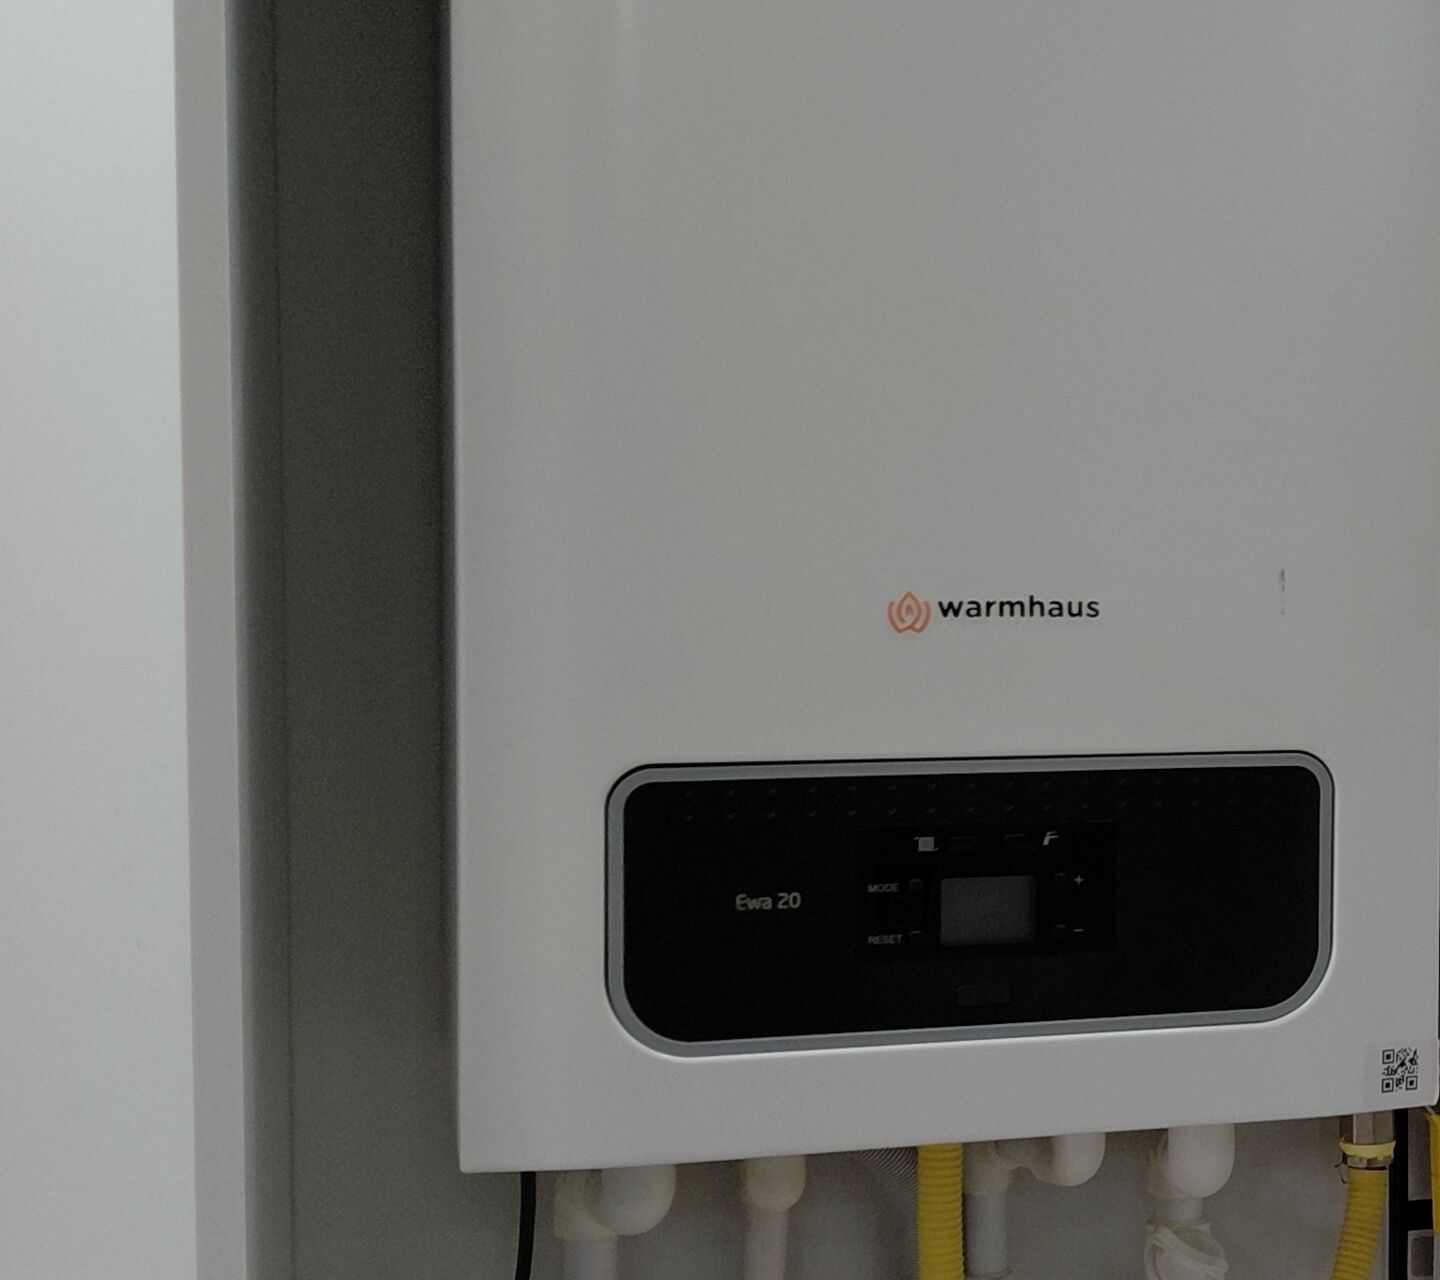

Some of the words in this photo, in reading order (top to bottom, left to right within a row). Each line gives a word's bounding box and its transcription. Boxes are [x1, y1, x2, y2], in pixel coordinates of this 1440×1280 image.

[938, 595, 1100, 618] warmhaus
[867, 883, 900, 893] MODE
[735, 893, 773, 911] Ewa
[777, 892, 802, 910] 20
[867, 934, 903, 945] RESET
